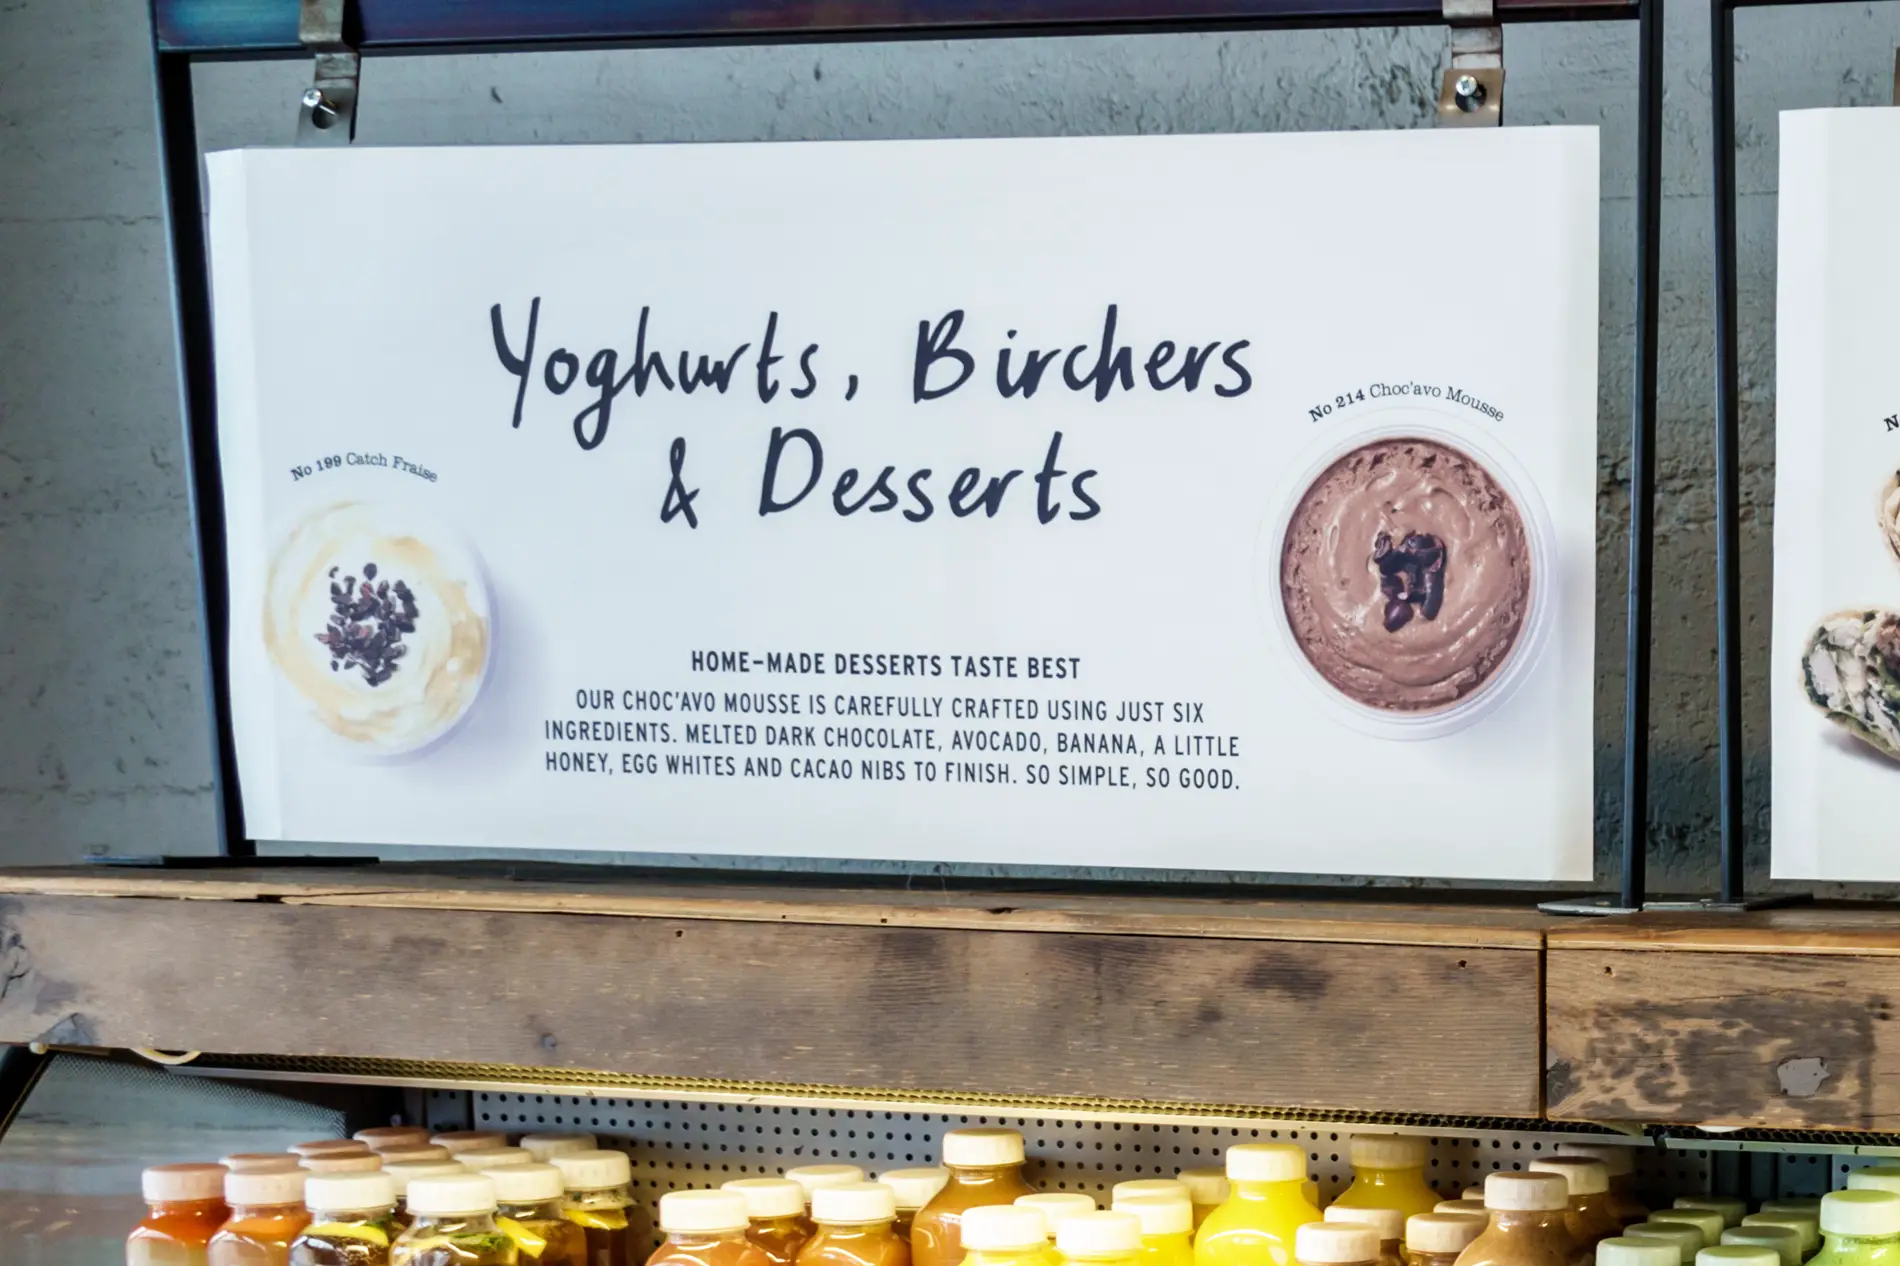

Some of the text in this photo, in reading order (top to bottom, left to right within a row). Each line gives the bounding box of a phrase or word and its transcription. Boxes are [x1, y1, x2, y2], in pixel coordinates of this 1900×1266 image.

[490, 296, 1254, 451] Yoghurts, Birchers
[1308, 381, 1504, 422] No 214 Choc'avo Mousse
[290, 452, 438, 482] No 199 Catch Fraise
[659, 426, 1101, 529] & Desserts
[691, 650, 1081, 680] HOME-MADE DESSERTS TASTE BEST
[575, 688, 1204, 724] OUR CHOC'AVO MOUSSE IS CAREFULLY CRAFTED USING JUST SIX
[544, 719, 1240, 758] INGREDIENTS. MELTED DARK CHOCOLATE, AVOCADO, BANANA, A LITTLE
